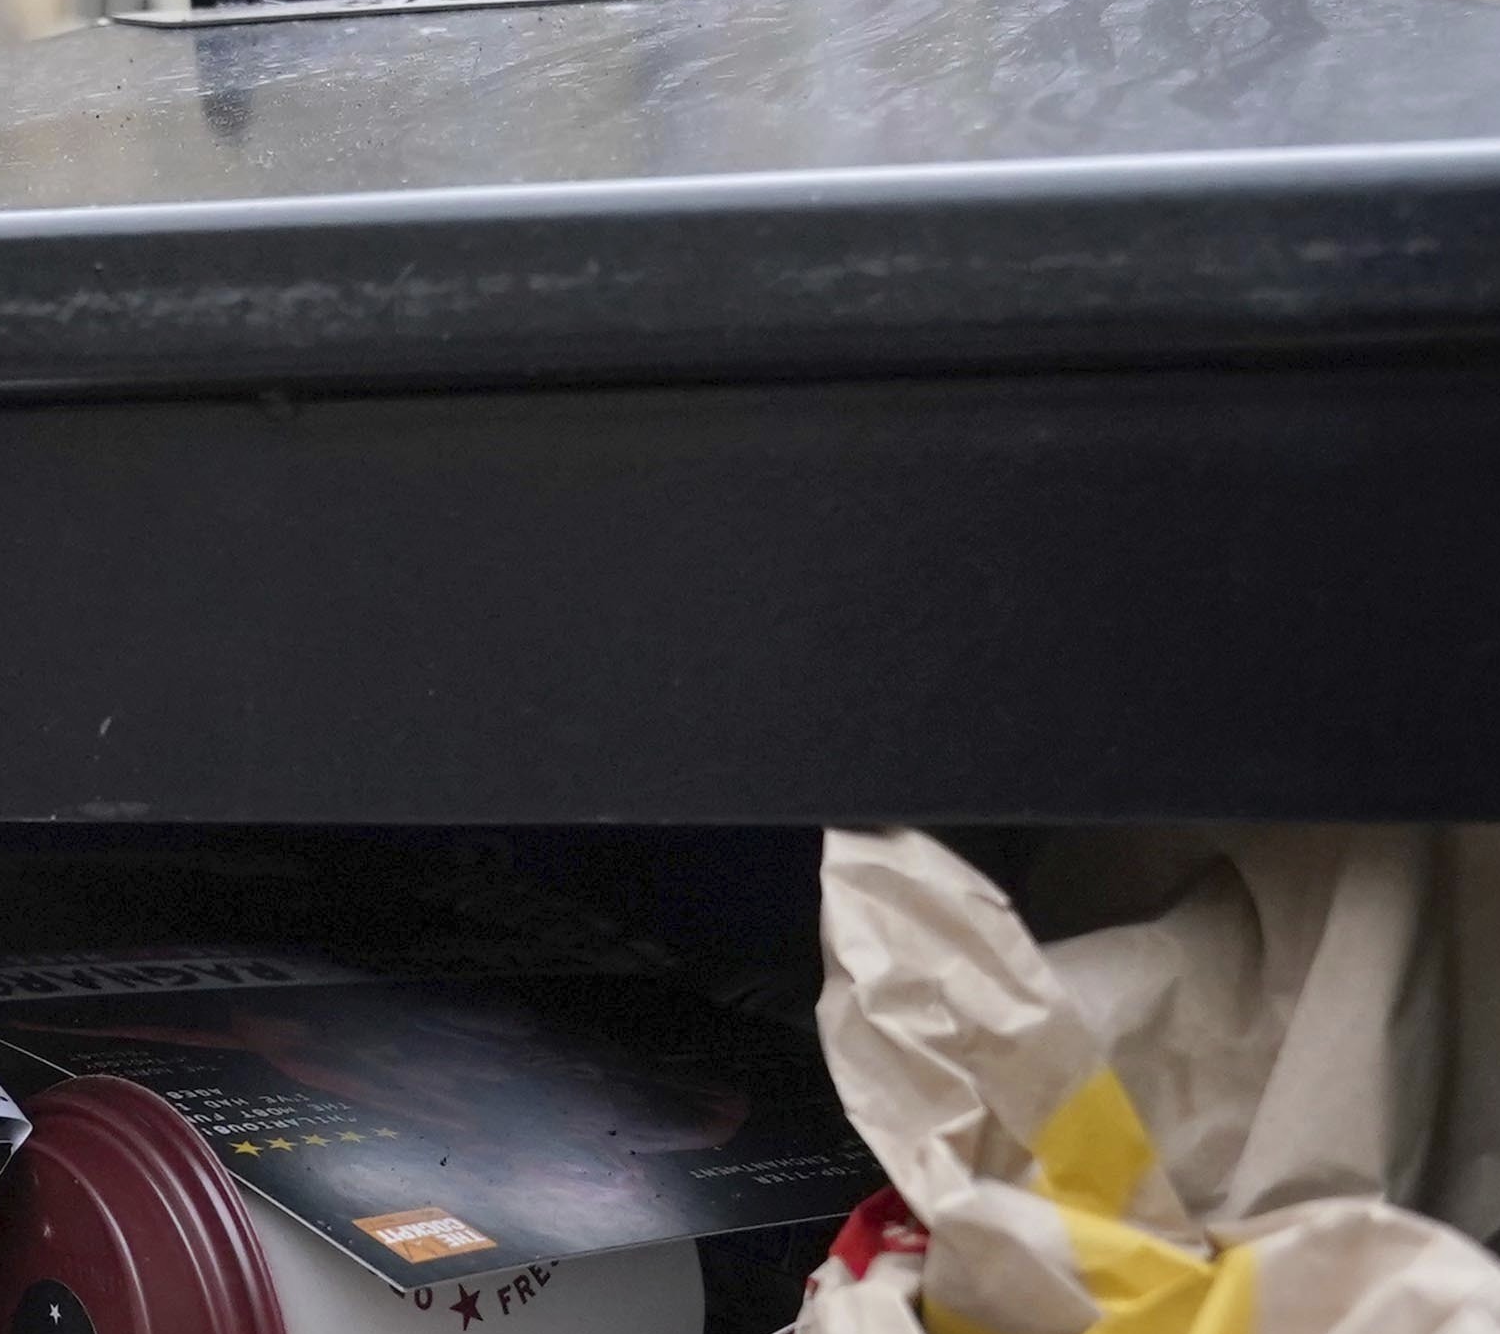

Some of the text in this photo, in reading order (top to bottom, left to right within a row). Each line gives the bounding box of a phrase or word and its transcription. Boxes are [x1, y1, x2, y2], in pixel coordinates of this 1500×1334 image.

[240, 1106, 297, 1120] MOST
[375, 1217, 465, 1245] COCKPIT
[437, 1230, 488, 1249] THE
[497, 1262, 557, 1316] FRE
